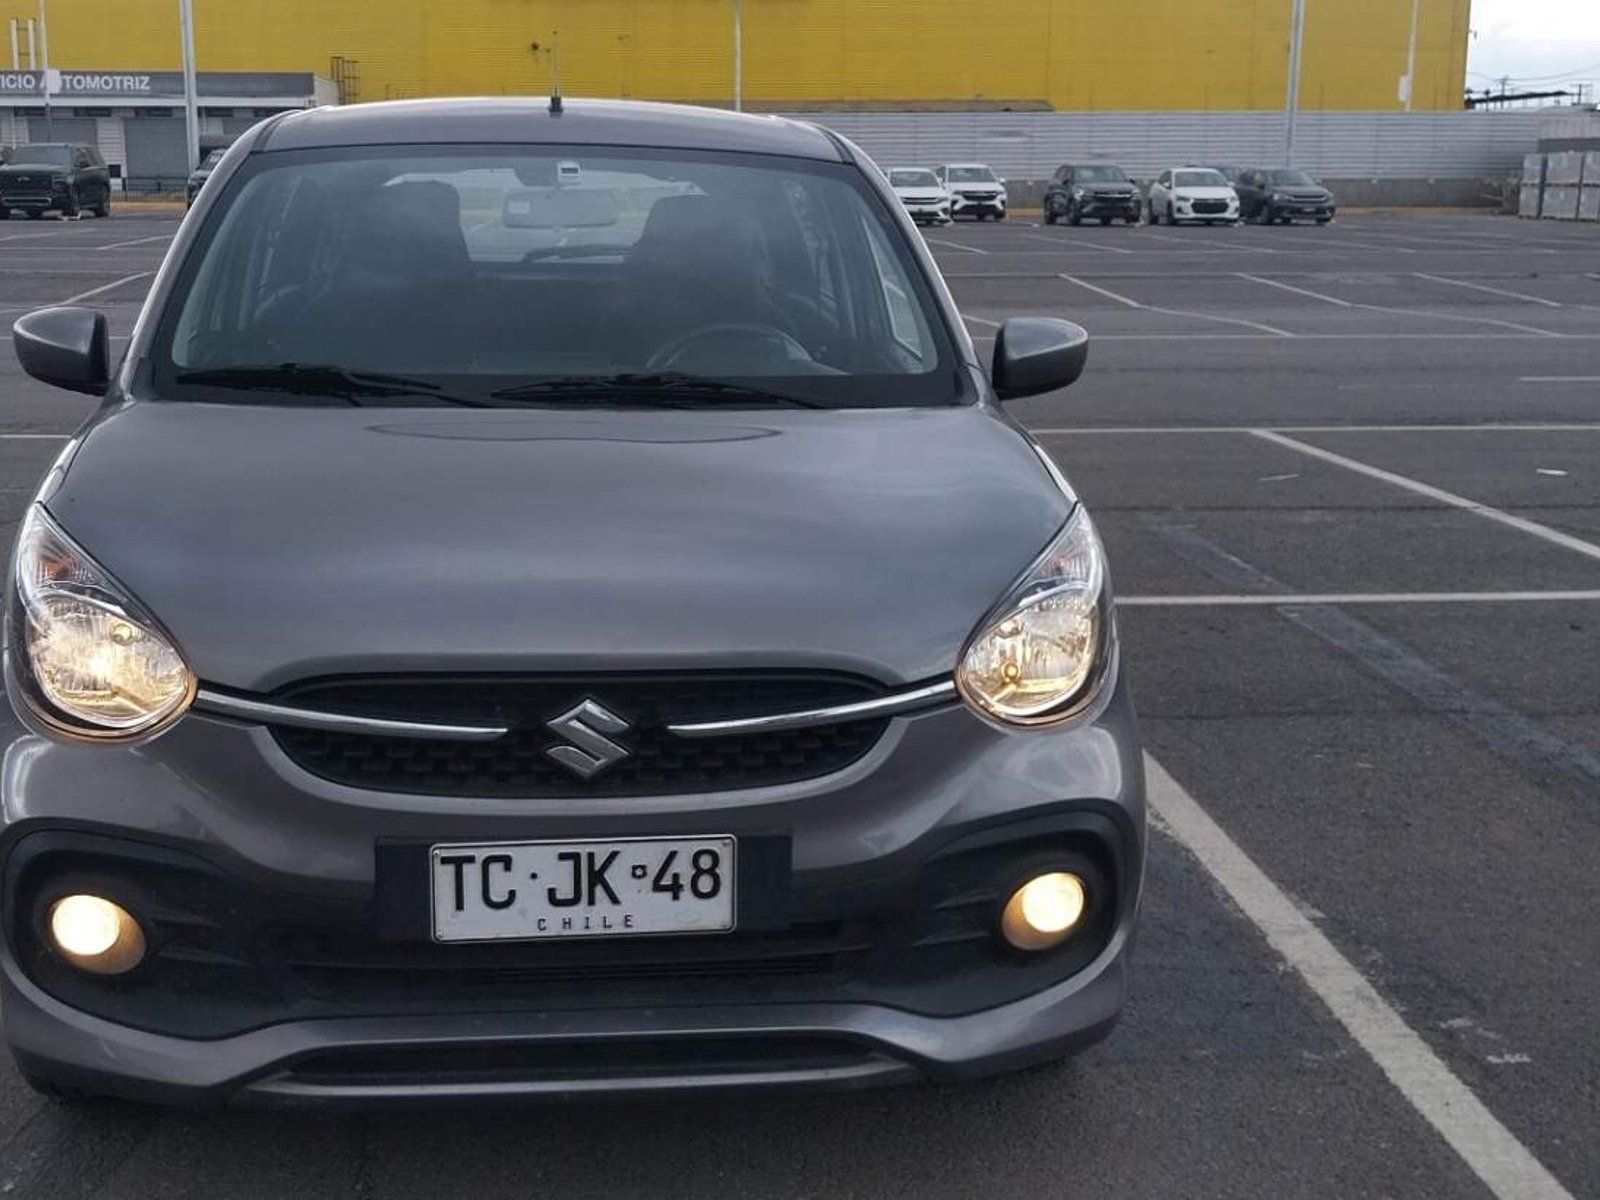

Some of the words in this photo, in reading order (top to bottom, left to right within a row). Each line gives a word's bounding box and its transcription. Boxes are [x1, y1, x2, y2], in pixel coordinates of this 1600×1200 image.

[0, 74, 35, 89] ICIO
[40, 74, 151, 89] TOMOTRIZ
[537, 914, 635, 932] CHILE
